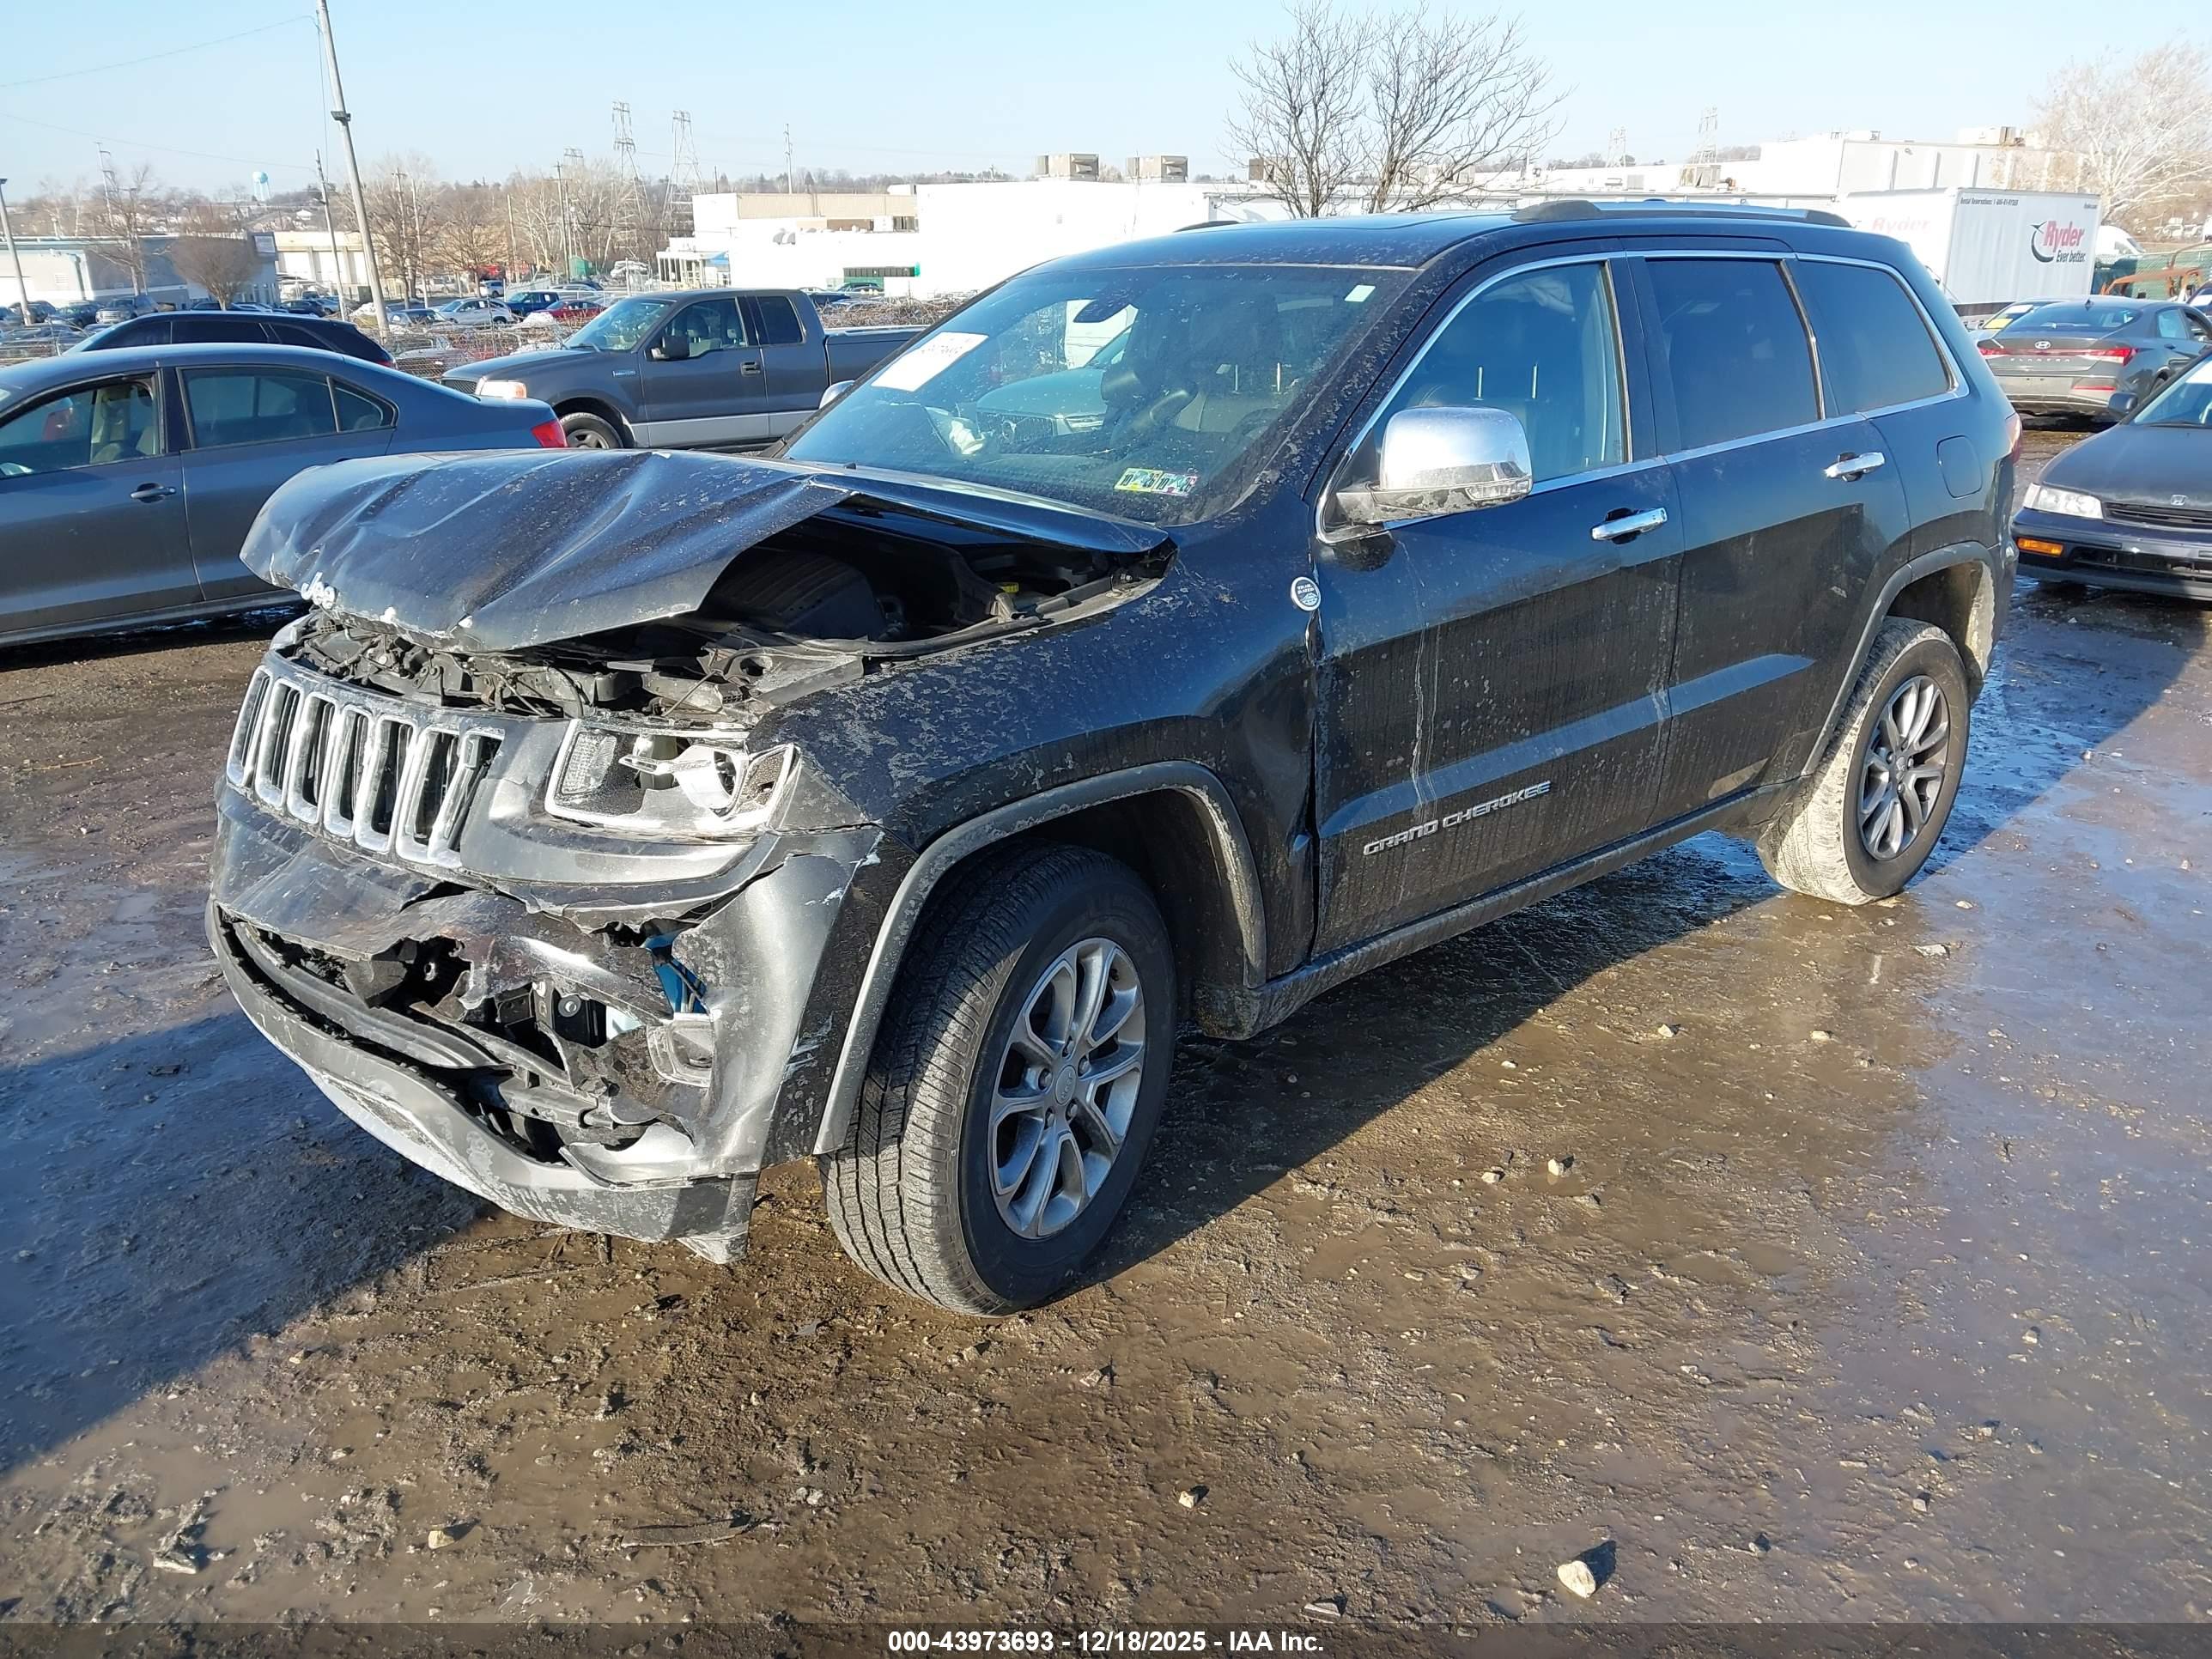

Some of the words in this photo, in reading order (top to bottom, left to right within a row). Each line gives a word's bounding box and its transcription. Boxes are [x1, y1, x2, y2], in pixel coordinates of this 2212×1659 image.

[1872, 216, 1930, 234] Ryder
[2043, 221, 2085, 252] Ryder
[2056, 250, 2069, 262] Ever
[1364, 819, 1439, 856] GRAND
[1443, 780, 1552, 829] CHEROKEE
